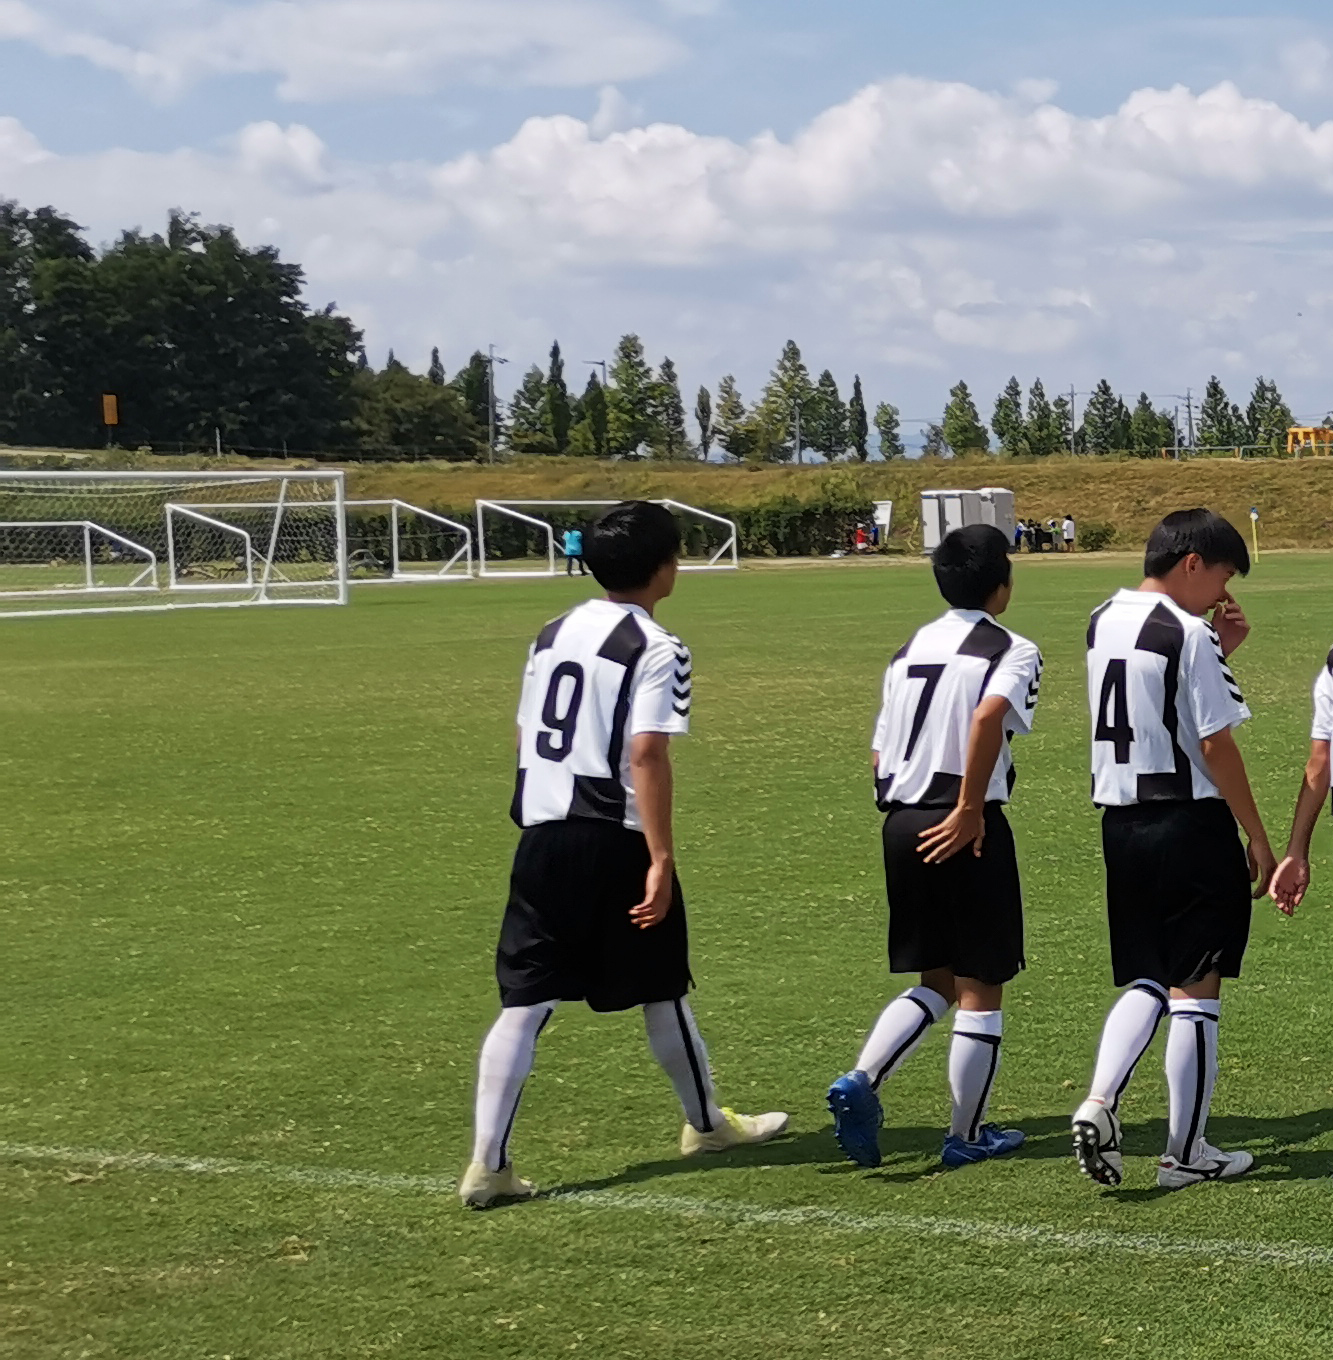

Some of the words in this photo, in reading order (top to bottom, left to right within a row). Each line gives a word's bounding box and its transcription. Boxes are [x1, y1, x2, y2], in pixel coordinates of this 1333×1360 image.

[536, 660, 584, 763] 9
[903, 663, 947, 762] 7
[1094, 658, 1135, 765] 4
